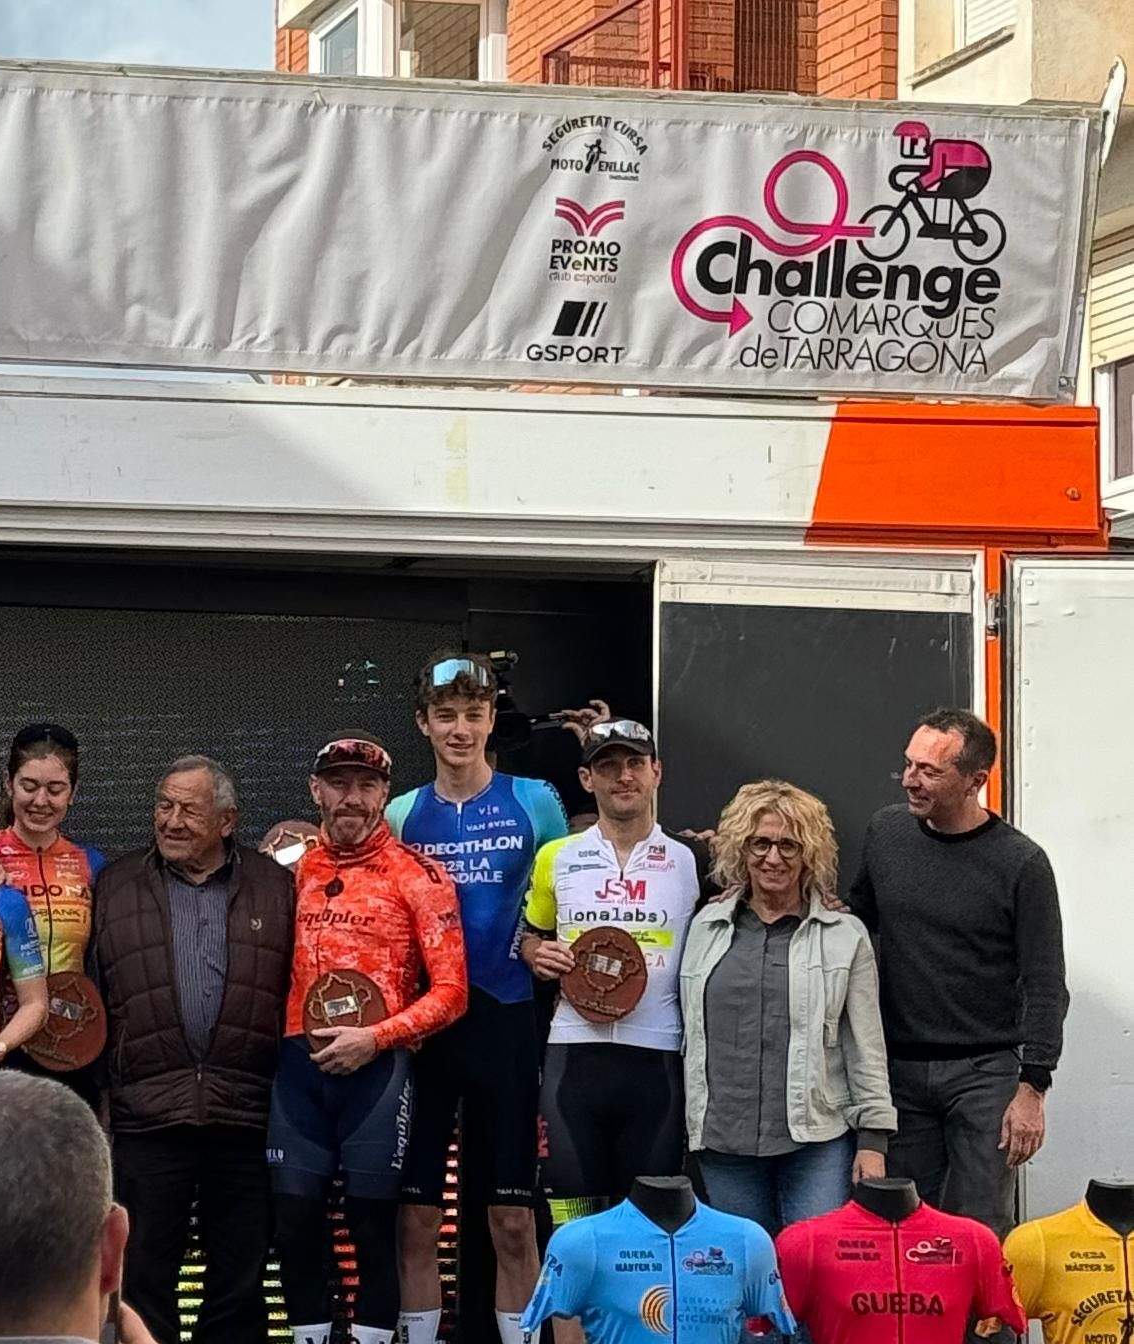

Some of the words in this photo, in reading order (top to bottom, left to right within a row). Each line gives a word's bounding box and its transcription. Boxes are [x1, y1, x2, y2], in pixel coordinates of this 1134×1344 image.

[542, 115, 612, 152] SEGURETAT
[613, 120, 649, 156] CURSA
[550, 158, 584, 171] MOTO
[551, 239, 621, 256] PROMO
[573, 272, 616, 286] esportiu
[696, 233, 1001, 320] Challenge
[766, 299, 997, 340] COMARQUES
[526, 344, 625, 364] GSPORT
[424, 835, 524, 855] DECATHLON
[469, 857, 491, 871] LA
[448, 870, 503, 884] NDIALE
[594, 879, 647, 901] JSM
[850, 1292, 945, 1316] GUEBA
[1070, 1289, 1134, 1328] SEGURETA
